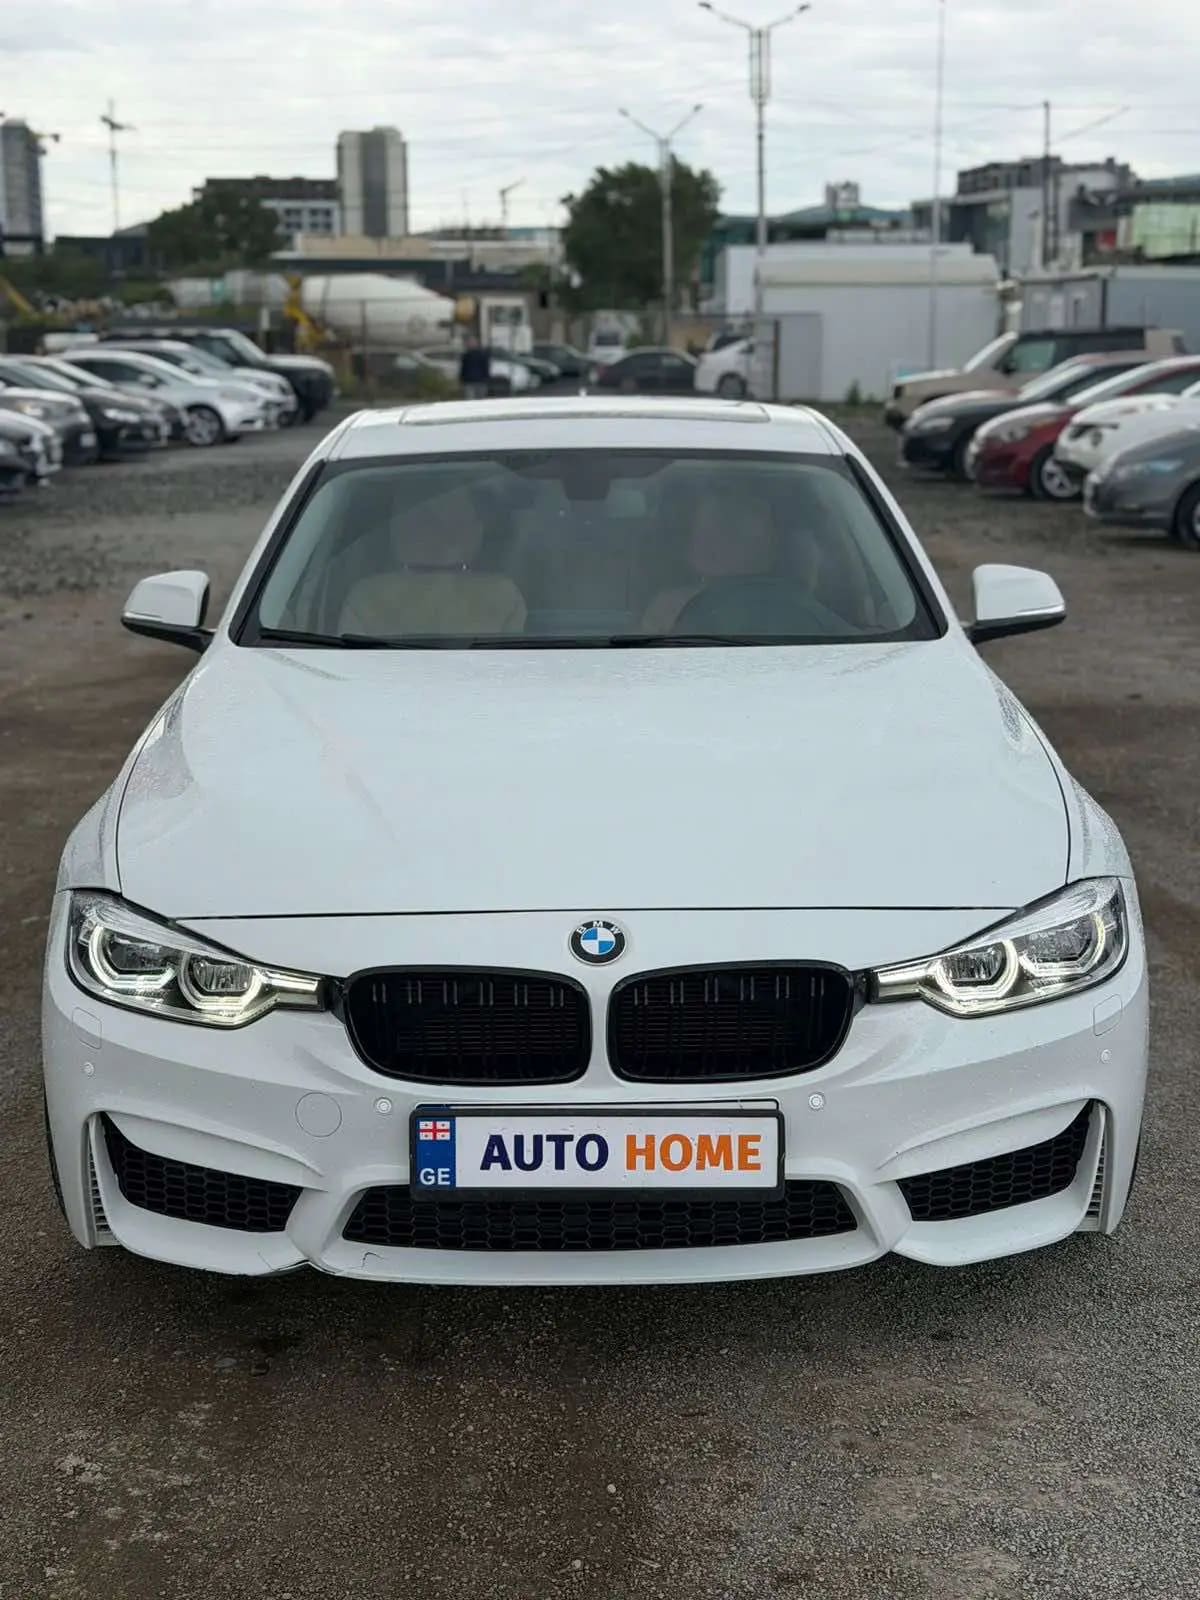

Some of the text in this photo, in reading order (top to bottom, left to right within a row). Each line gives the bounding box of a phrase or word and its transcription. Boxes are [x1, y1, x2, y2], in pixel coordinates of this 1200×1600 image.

[576, 920, 621, 934] BMW
[480, 1134, 761, 1171] AUTO HOME
[419, 1168, 450, 1185] GE
